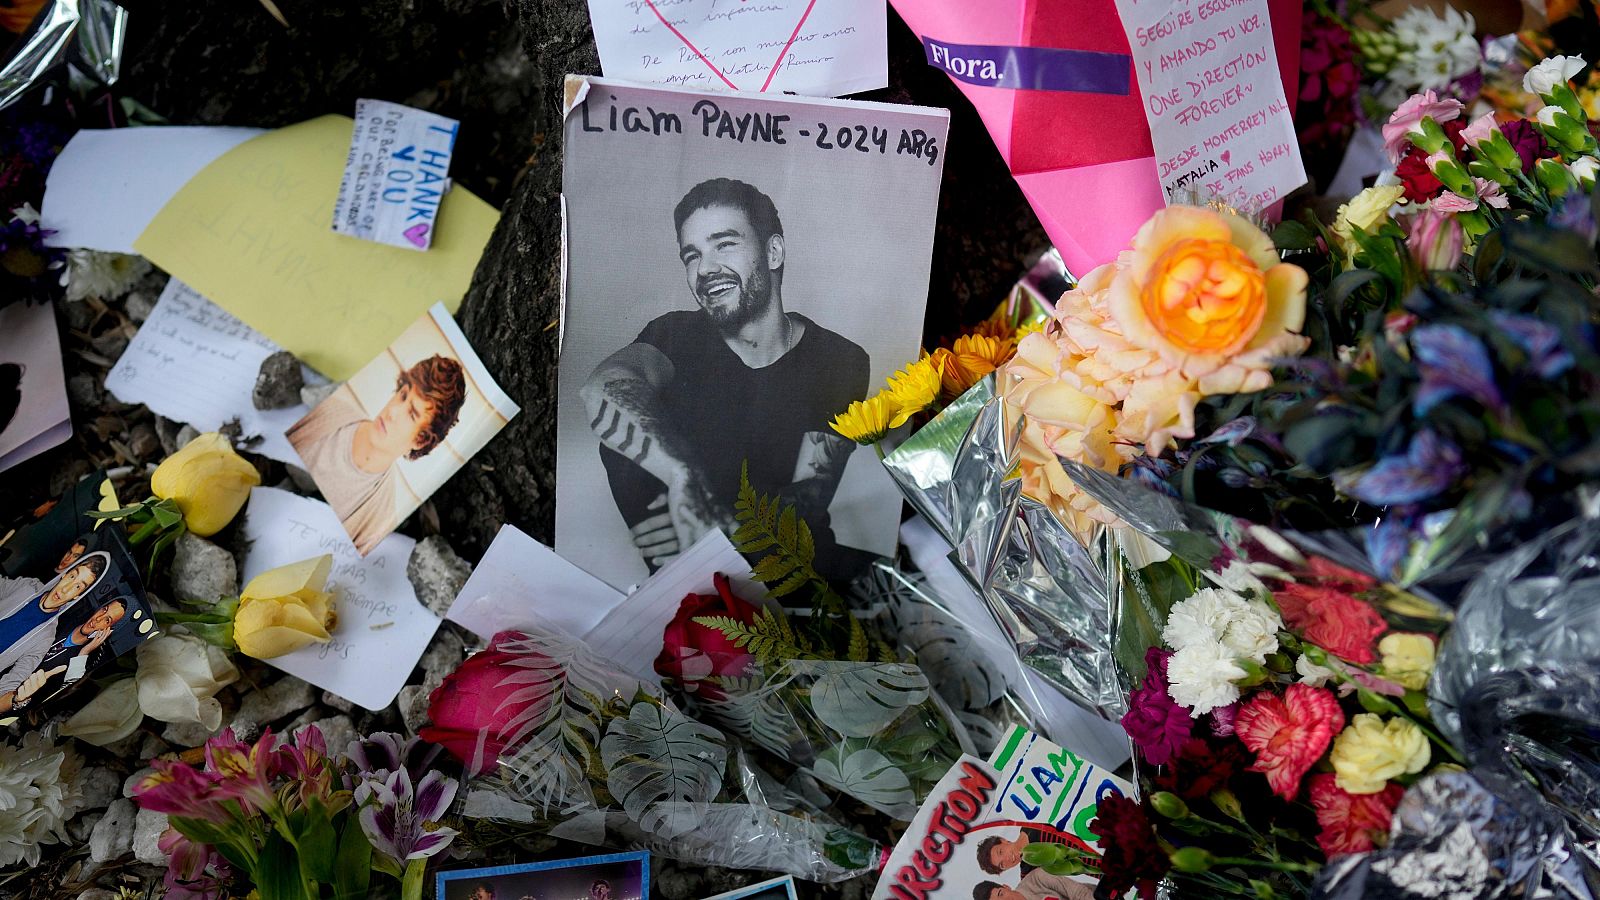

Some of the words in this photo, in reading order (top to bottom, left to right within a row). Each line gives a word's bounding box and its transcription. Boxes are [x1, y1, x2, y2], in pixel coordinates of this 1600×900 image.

[722, 46, 747, 57] con
[930, 43, 1004, 80] Flora.
[1143, 60, 1152, 84] Y
[1160, 38, 1217, 72] AMANDO
[1218, 26, 1236, 42] TU
[1149, 88, 1182, 116] ONE
[582, 95, 682, 136] Liam
[692, 100, 790, 145] PAYNE
[897, 129, 938, 166] ARG
[1160, 145, 1199, 178] DESDE
[1203, 110, 1267, 152] MONTERREY
[382, 145, 414, 203] YOU
[406, 123, 460, 221] THANK
[1224, 161, 1254, 183] FANS
[287, 518, 318, 539] TE
[320, 535, 359, 558] VAMO
[373, 555, 385, 569] A
[332, 560, 367, 584] MAR
[885, 761, 996, 900] IRECTION
